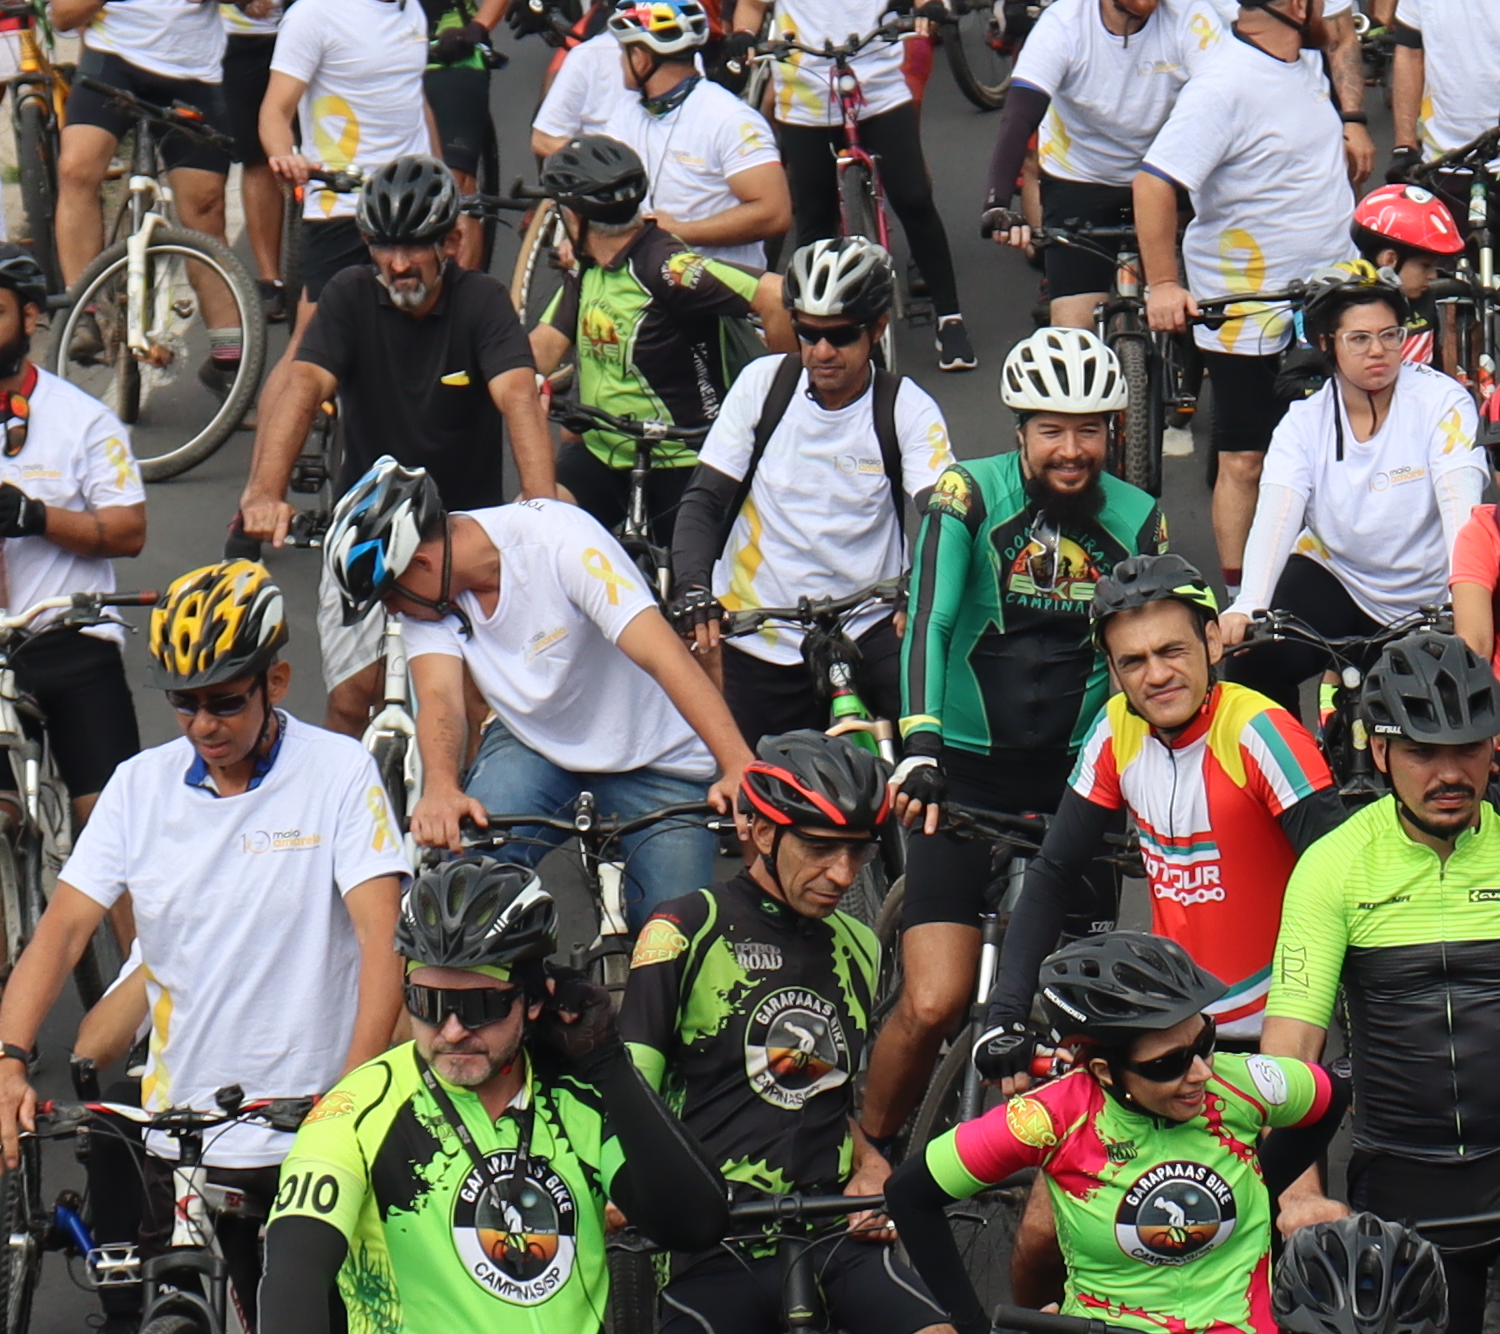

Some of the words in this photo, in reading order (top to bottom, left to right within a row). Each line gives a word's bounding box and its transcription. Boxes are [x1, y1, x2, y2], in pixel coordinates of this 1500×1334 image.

[1004, 593, 1089, 616] CAMPINA
[273, 829, 300, 840] maio
[737, 953, 783, 971] ROAD
[756, 989, 833, 1027] GARAPAAAS
[827, 1013, 847, 1053] BIKE
[544, 1176, 572, 1214] BIKE
[1122, 1162, 1201, 1206] GARAPAAAS
[1204, 1168, 1231, 1206] BIKE
